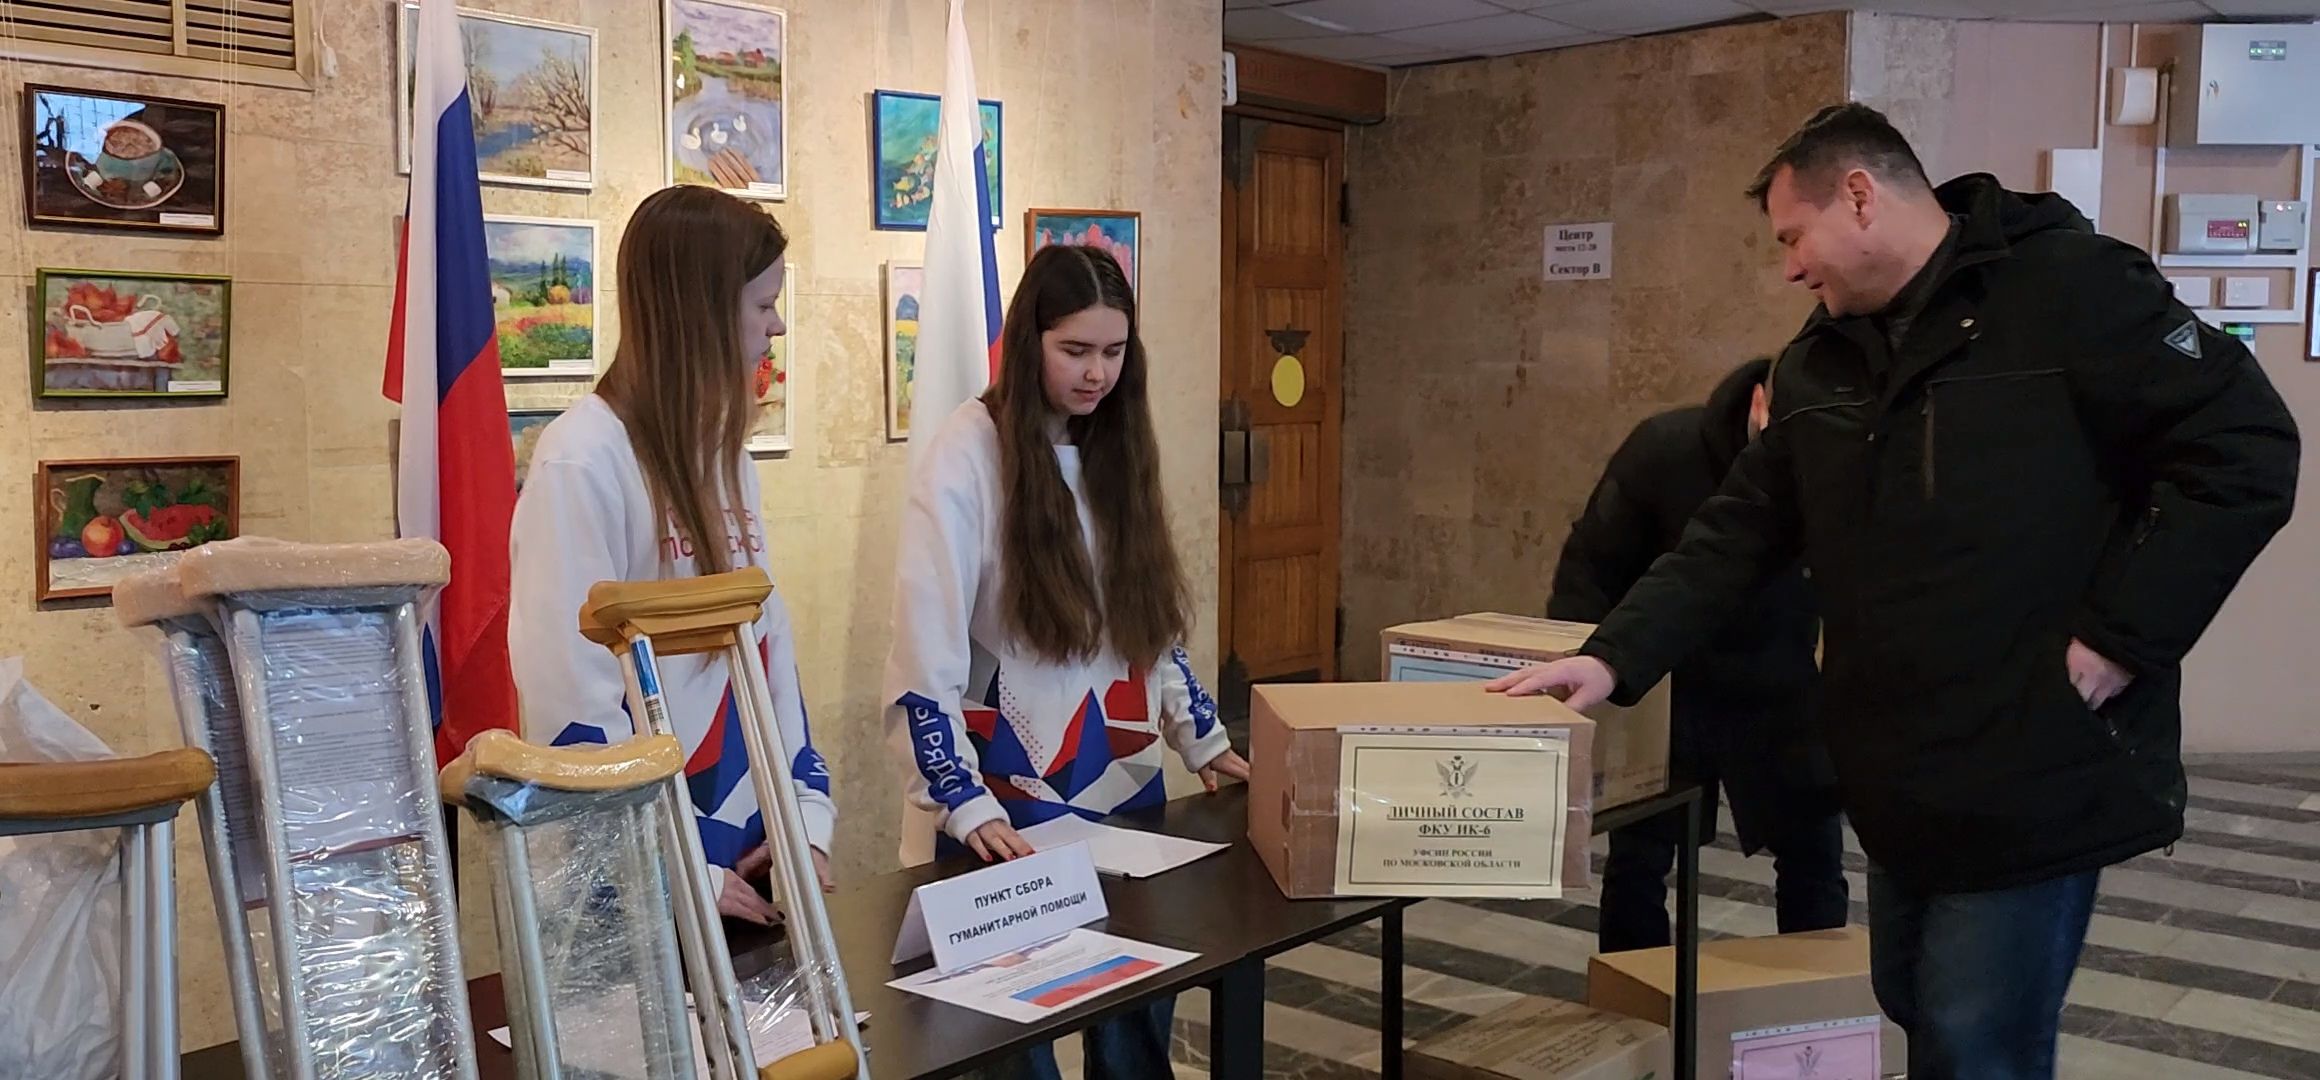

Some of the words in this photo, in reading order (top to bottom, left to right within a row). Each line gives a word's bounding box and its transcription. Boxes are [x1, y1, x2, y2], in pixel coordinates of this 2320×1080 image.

[1559, 229, 1594, 242] Центр
[1549, 263, 1590, 277] Сектор
[1387, 804, 1458, 820] ЛИЧНЫЙ
[1462, 806, 1525, 820] СОСТАВ
[1418, 823, 1452, 836] ФКУ
[1456, 824, 1492, 836] ИК-6
[1413, 849, 1450, 858] УФСИН
[1451, 849, 1493, 858] РОССИИ
[1382, 859, 1398, 868] ПО
[1400, 858, 1472, 869] МОСКОВСКОЙ
[1473, 859, 1521, 869] ОБЛАСТИ
[974, 887, 1012, 910] ПУНКТ
[1015, 875, 1054, 897] СБОРА
[948, 905, 1038, 945] ГУМАНИТАРНОЙ
[1040, 891, 1088, 916] ПОМОЩИ
